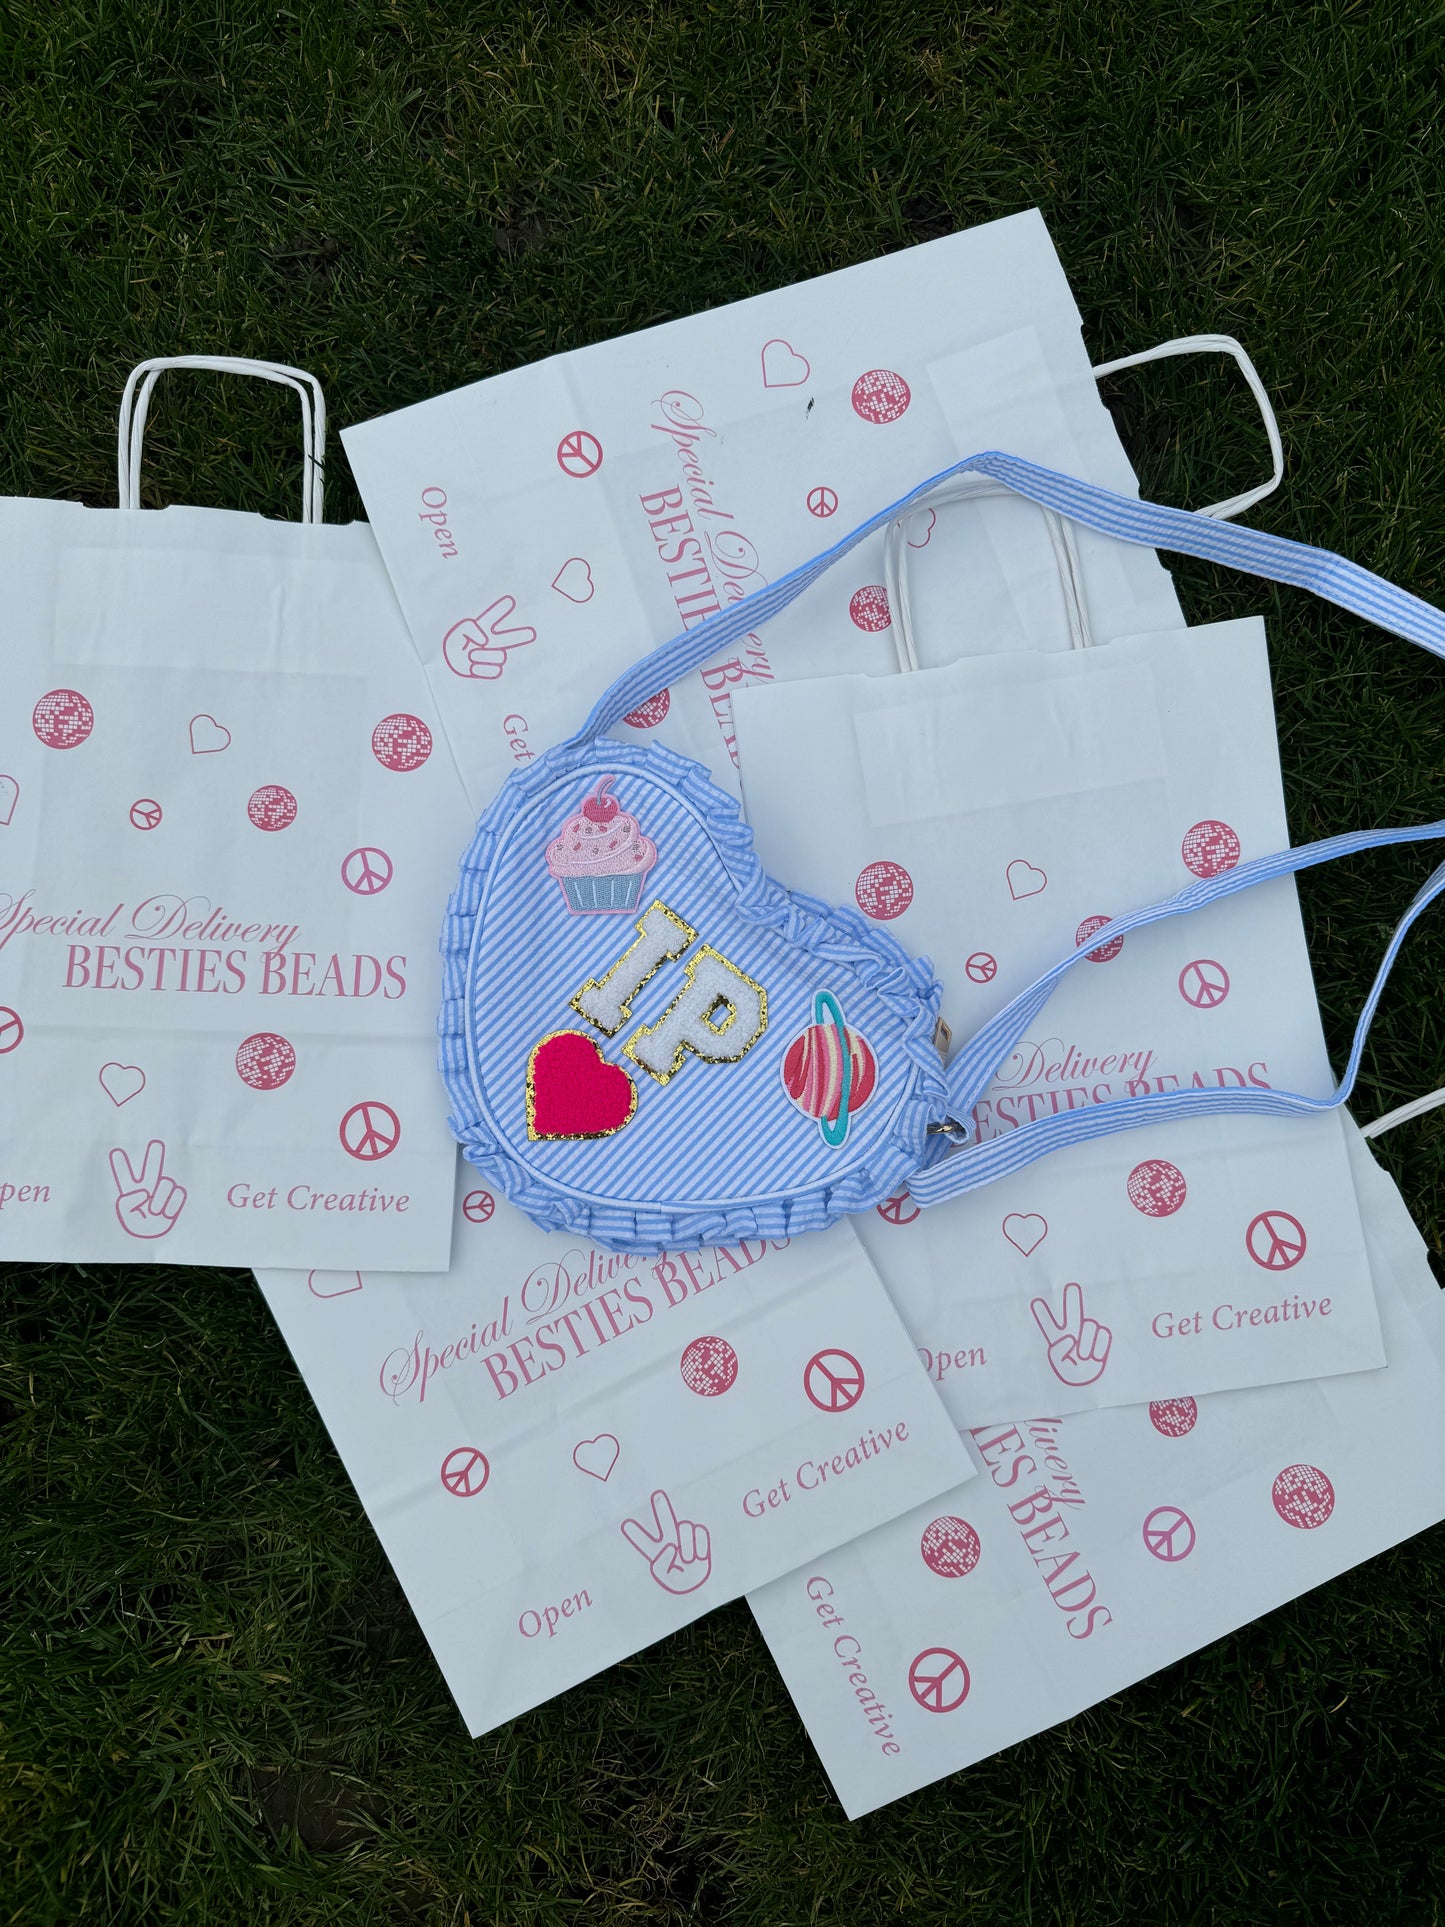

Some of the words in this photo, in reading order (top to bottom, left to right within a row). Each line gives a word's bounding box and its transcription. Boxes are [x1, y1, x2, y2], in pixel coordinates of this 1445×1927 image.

[419, 486, 459, 560] Open
[639, 484, 722, 632] BESTIE
[651, 390, 735, 521] Special
[704, 530, 776, 685] Deery
[503, 713, 536, 761] Get
[125, 894, 301, 964] Delivery
[62, 944, 247, 995] BESTIES
[258, 950, 408, 1000] BEADS
[992, 1037, 1158, 1090] Delivery
[0, 1182, 51, 1210] pen
[227, 1183, 278, 1209] Get
[286, 1184, 411, 1213] Creative
[378, 1296, 513, 1406] Special
[480, 1276, 654, 1400] BESTIES
[1151, 1312, 1203, 1339] Get
[1212, 1296, 1333, 1331] Creative
[742, 1477, 790, 1519] Get
[796, 1421, 911, 1491] Creative
[1006, 1484, 1113, 1640] BEADS
[518, 1588, 594, 1639] Open
[806, 1575, 846, 1629] Get
[833, 1634, 901, 1757] Creative
